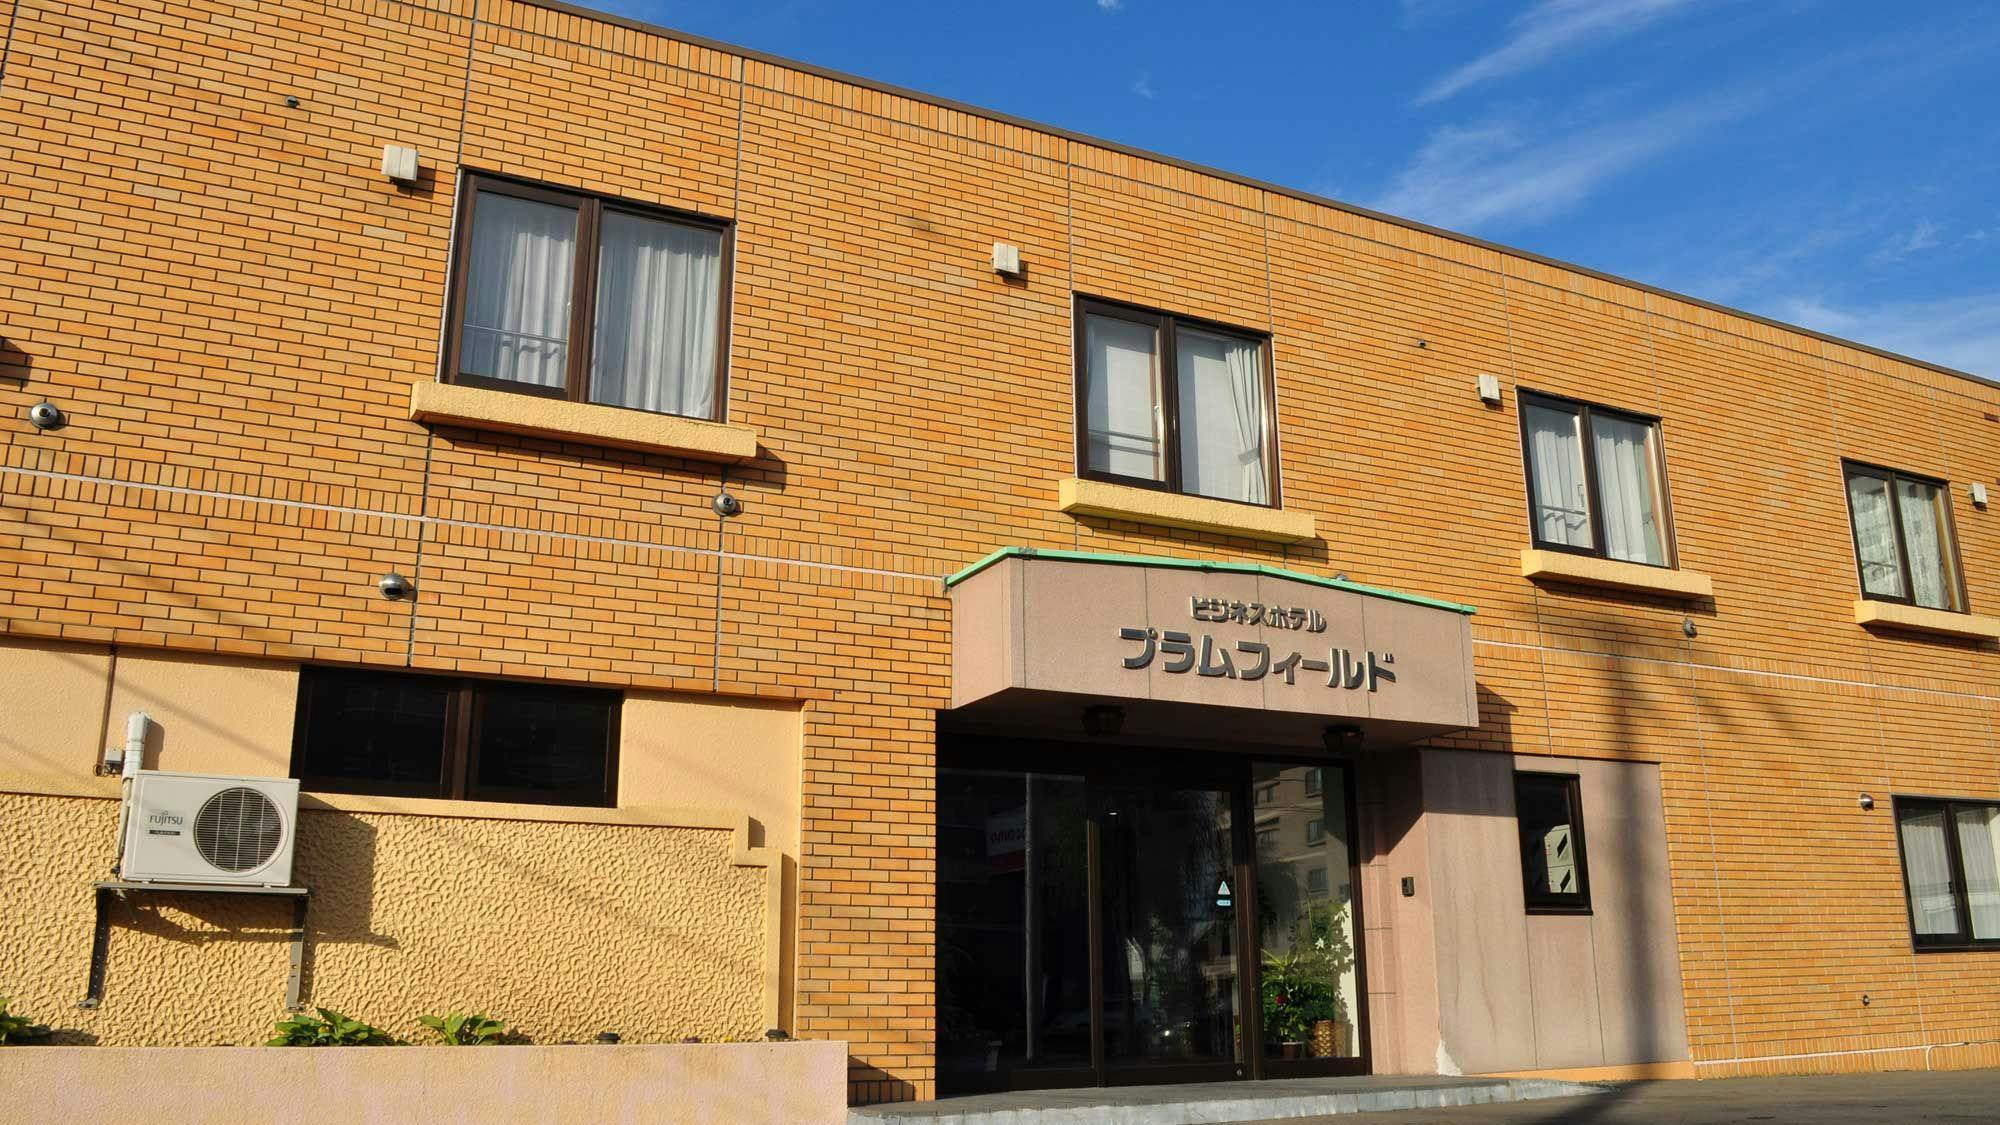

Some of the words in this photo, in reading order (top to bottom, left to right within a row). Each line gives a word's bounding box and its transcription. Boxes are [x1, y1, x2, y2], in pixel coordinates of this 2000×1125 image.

[1190, 595, 1327, 633] ビジネスホテル
[1118, 626, 1396, 692] プラムフィールド
[149, 814, 183, 826] FUJITSU
